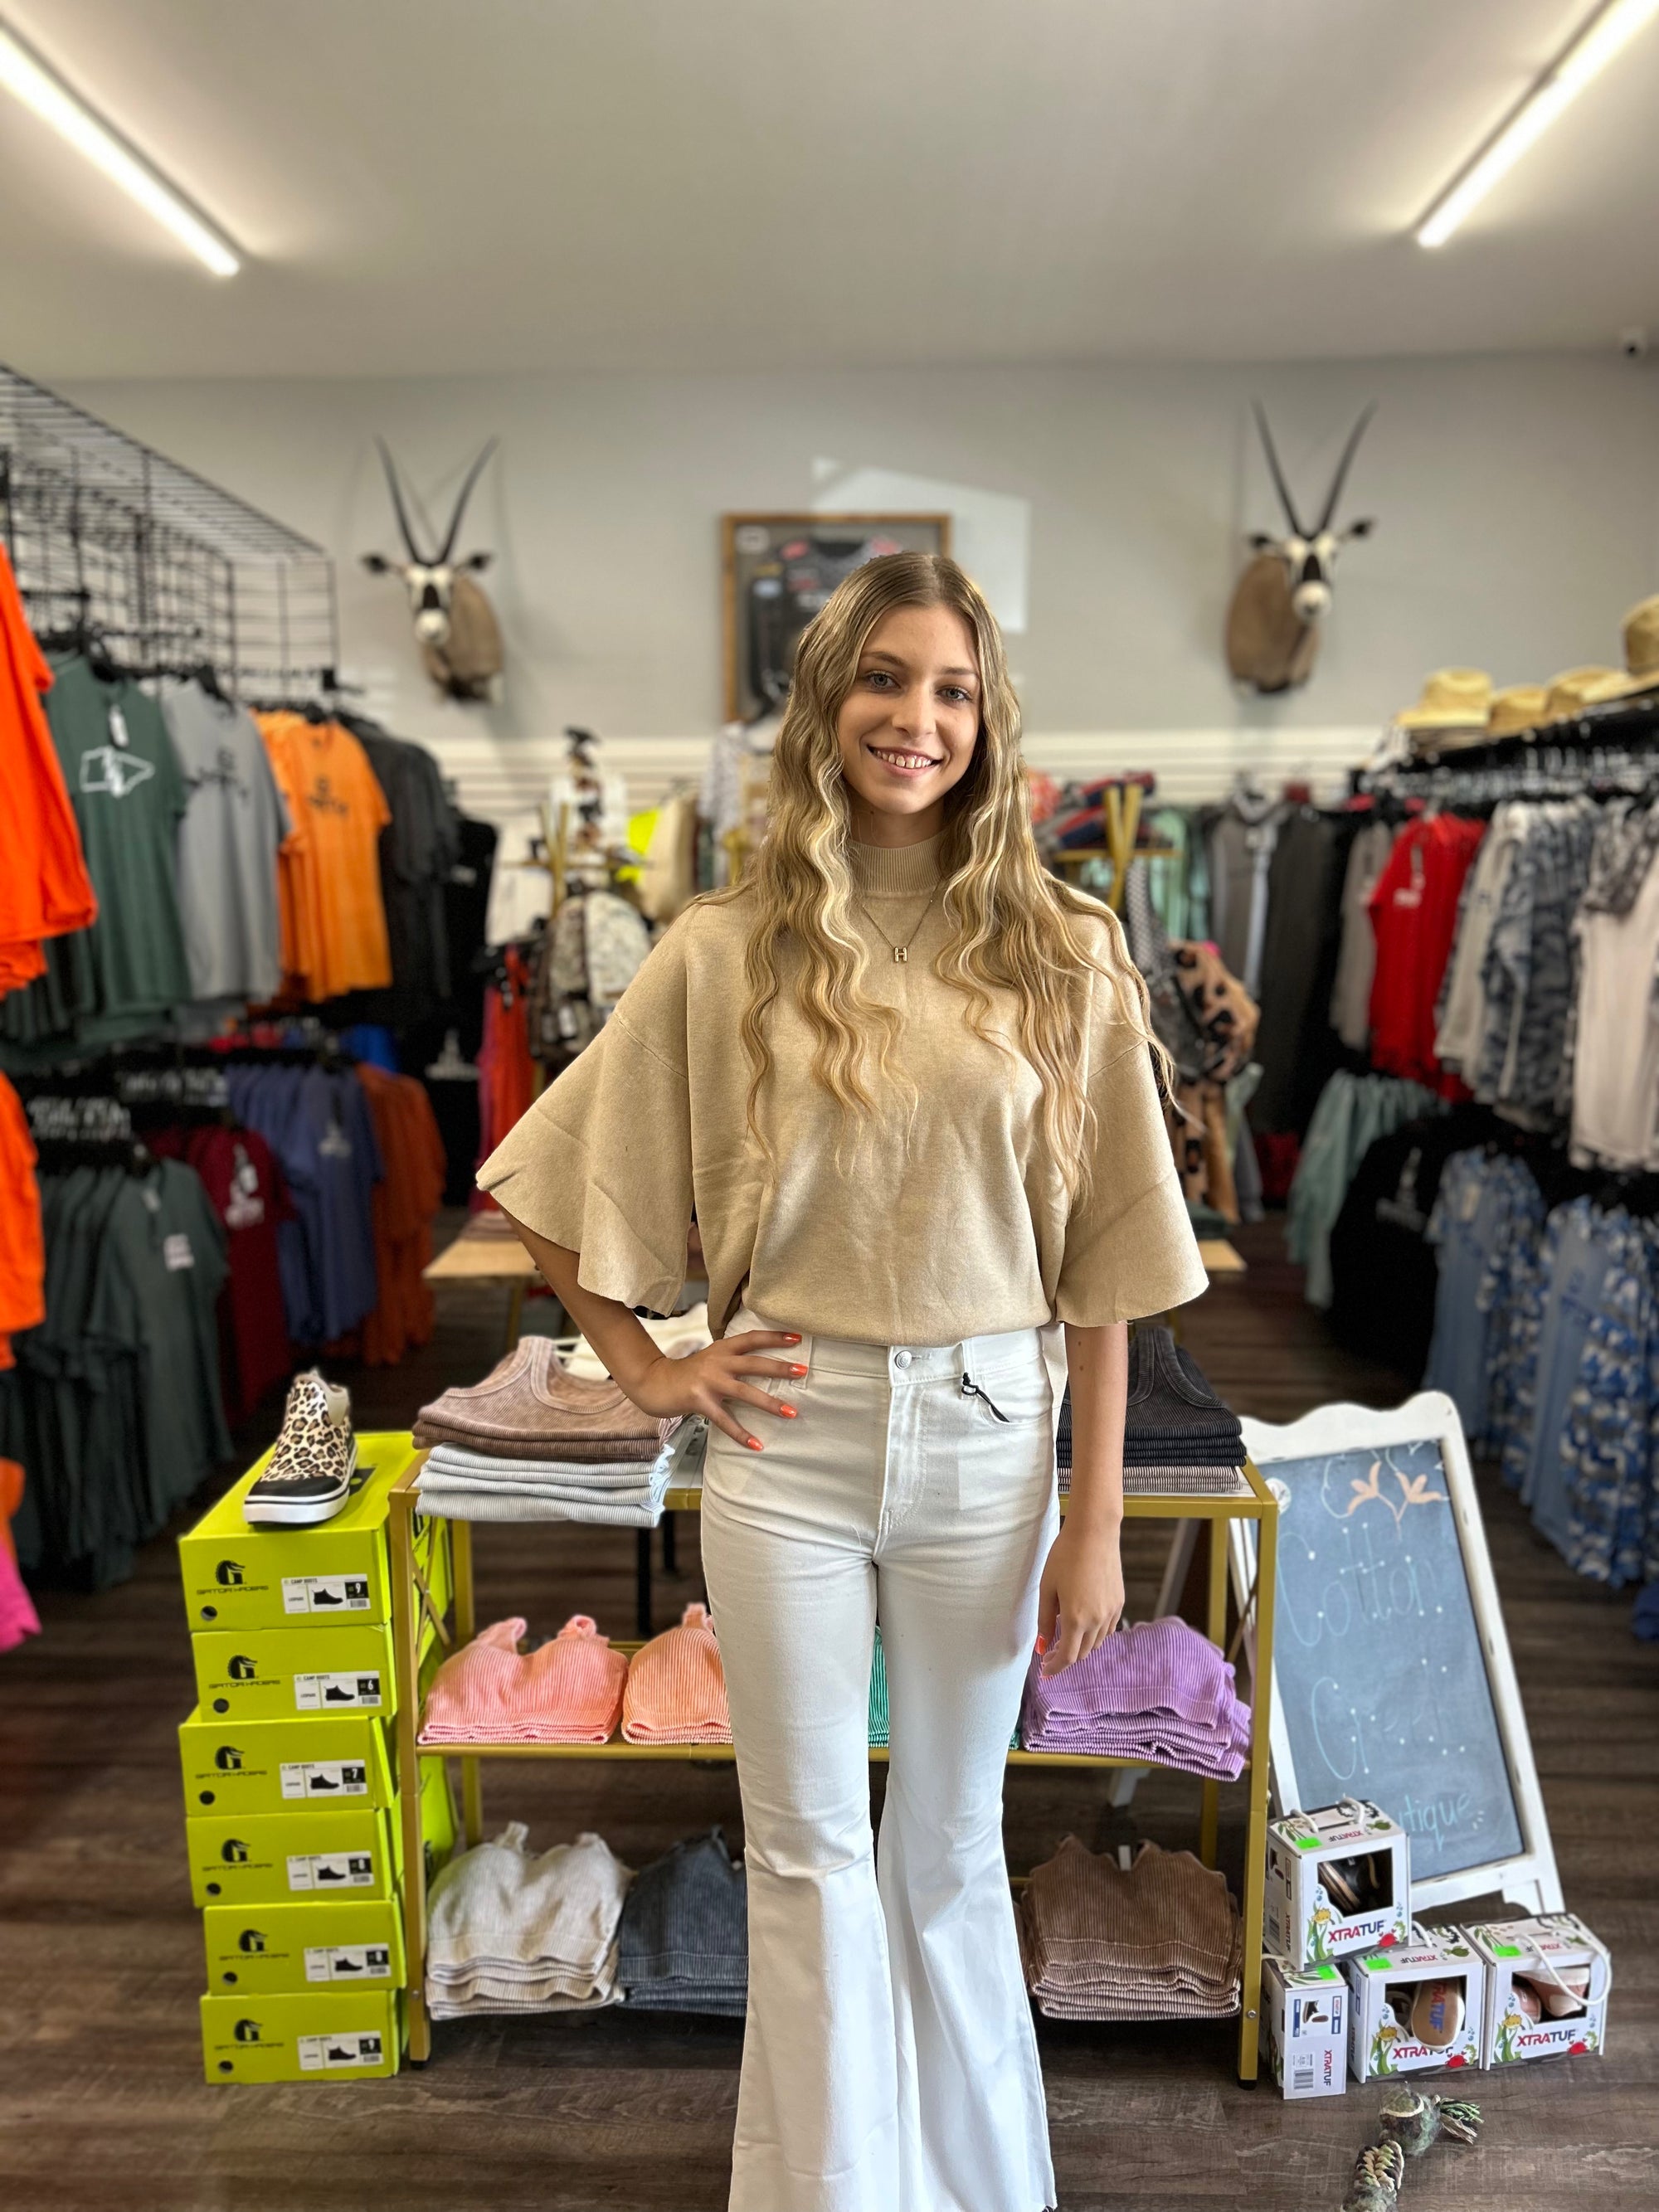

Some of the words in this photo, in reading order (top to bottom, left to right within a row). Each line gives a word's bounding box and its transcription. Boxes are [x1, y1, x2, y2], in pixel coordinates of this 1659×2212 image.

[894, 946, 907, 963] H
[355, 1582, 362, 1593] 9
[1276, 1523, 1445, 1647] Cotton
[367, 1680, 374, 1690] 6
[352, 1768, 358, 1779] 7
[1328, 1830, 1364, 1843] XTRATUF
[1328, 1920, 1384, 1944] XTRATUF
[1400, 1954, 1438, 1964] XTRATUF
[1516, 2030, 1576, 2047] XTRATUF
[1324, 2049, 1332, 2087] XTRATUF
